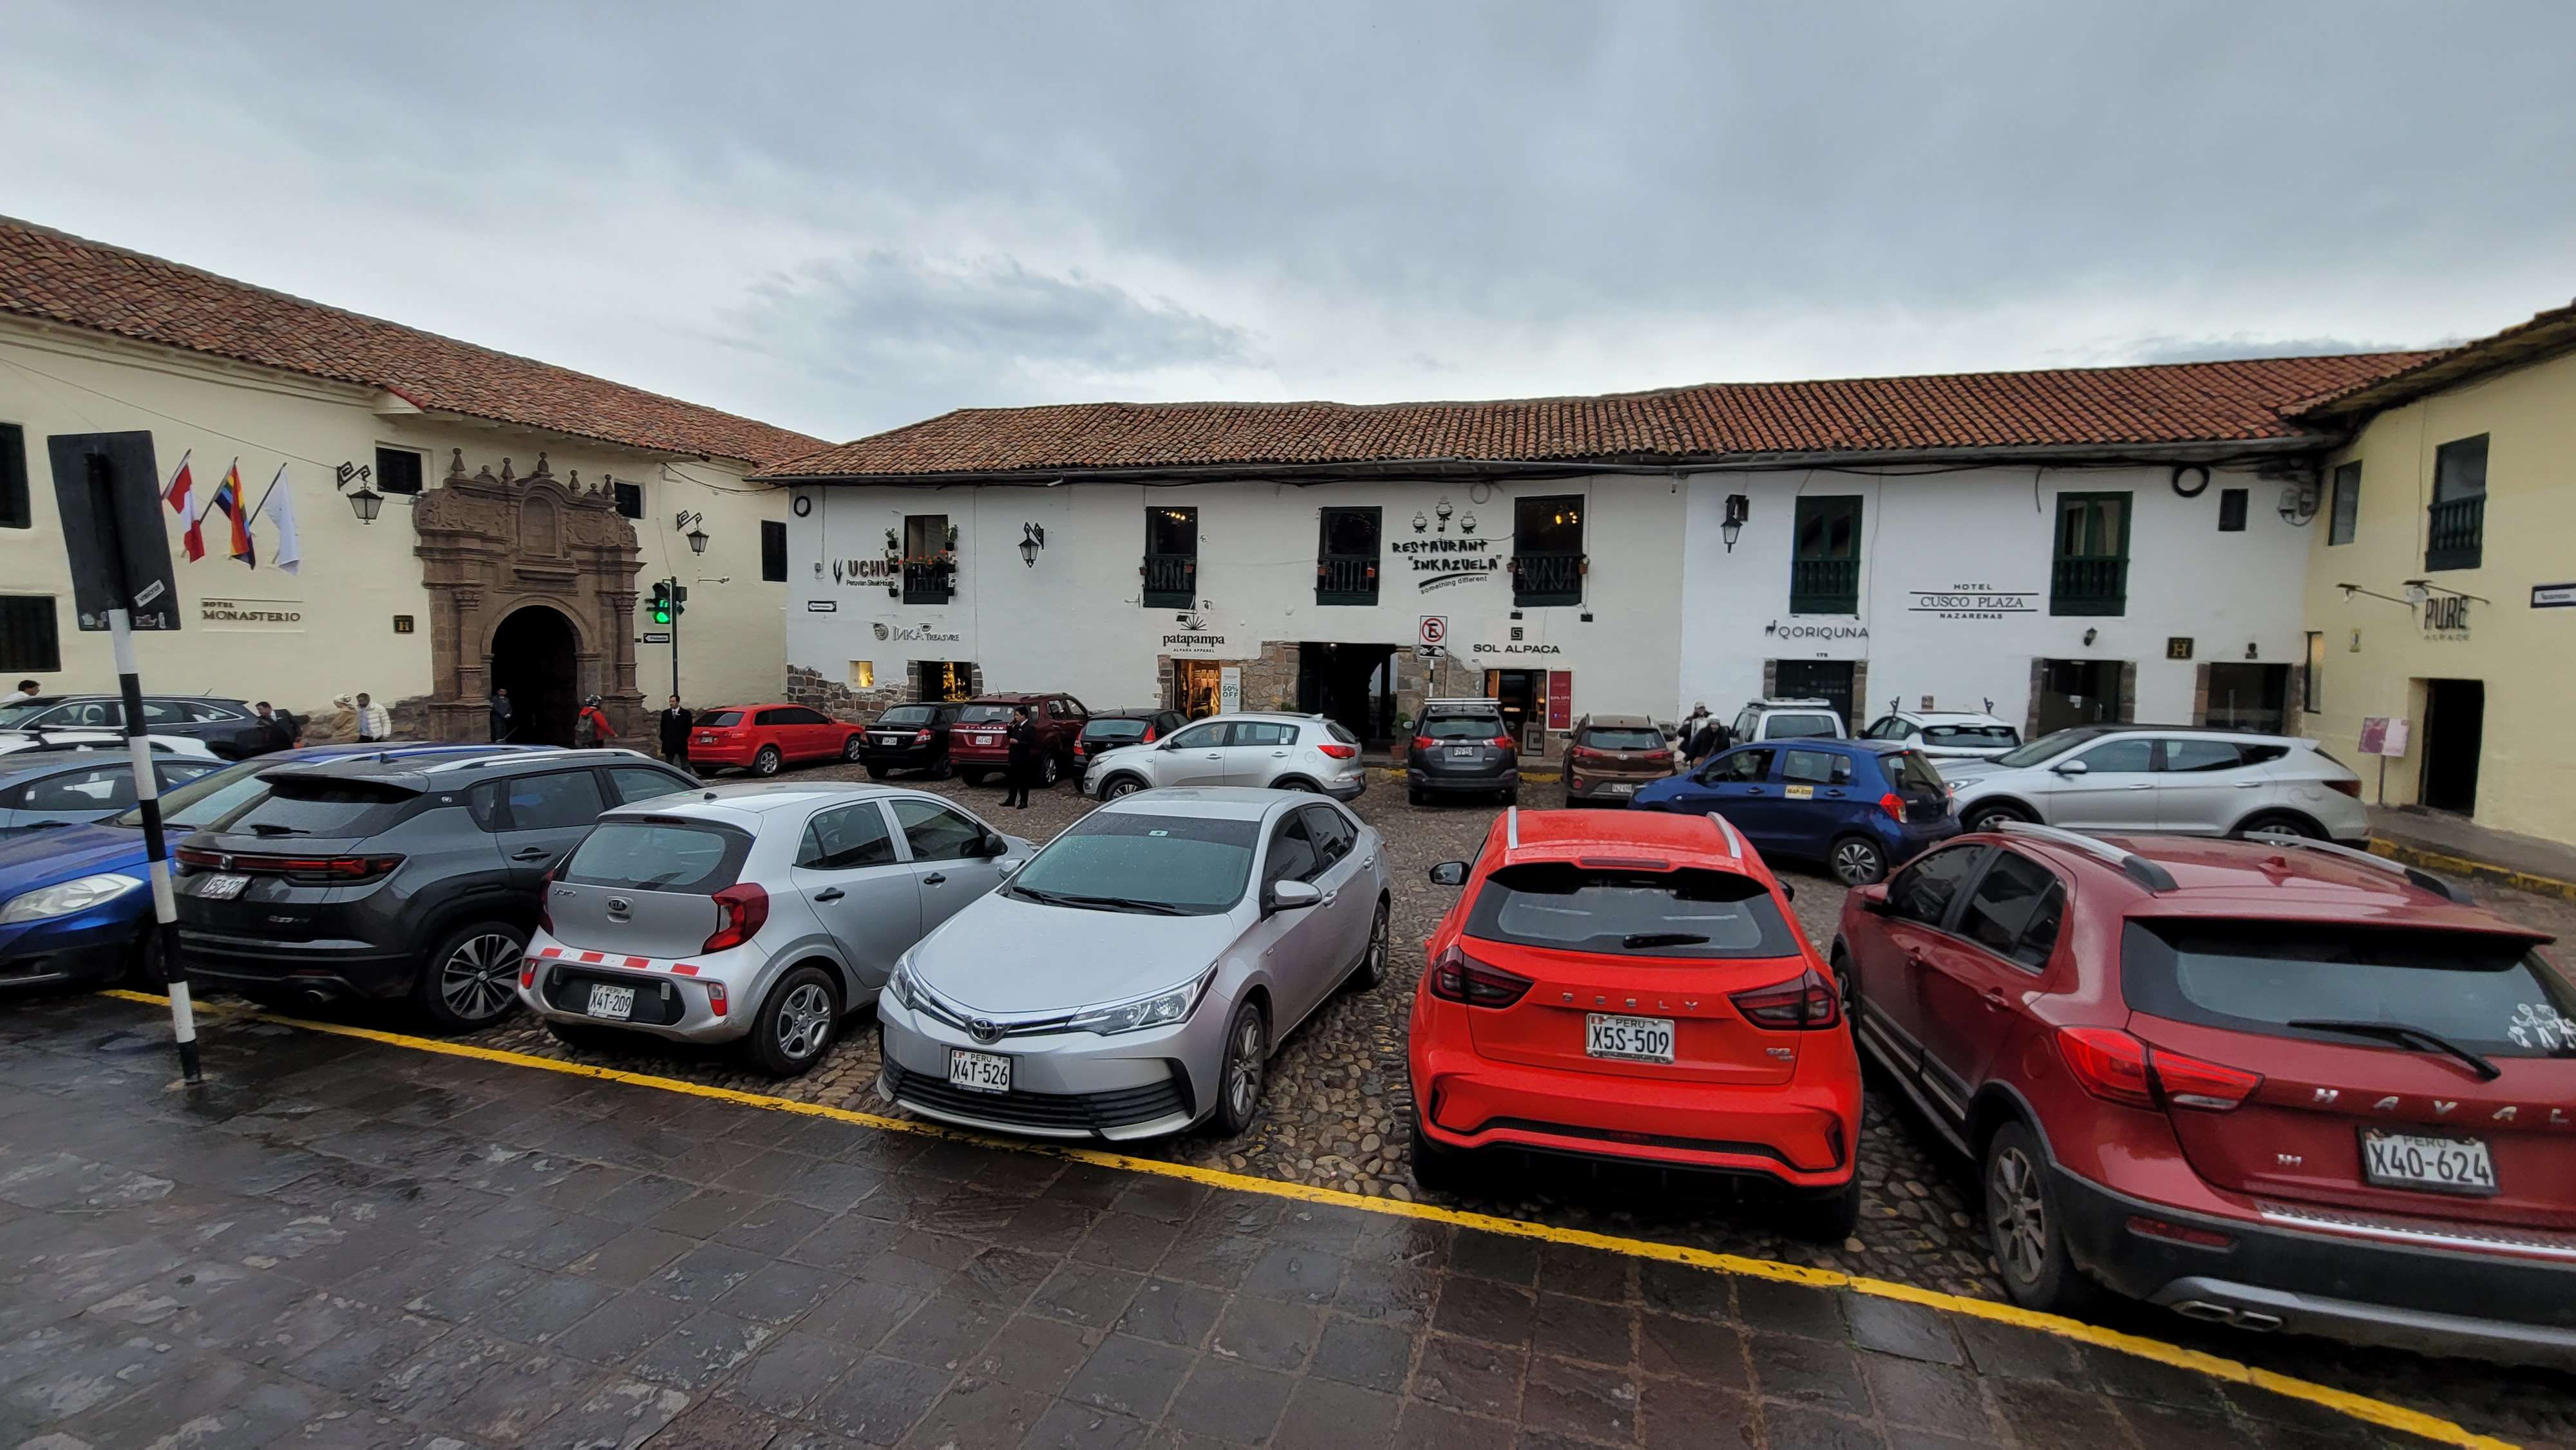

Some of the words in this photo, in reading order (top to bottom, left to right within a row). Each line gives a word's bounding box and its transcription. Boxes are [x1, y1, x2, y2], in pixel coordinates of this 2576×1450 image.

[1392, 540, 1488, 553] RESTAURANT
[848, 560, 891, 577] UCHU
[1408, 554, 1502, 572] "INKAZUELA"
[1421, 580, 1456, 594] something
[1458, 575, 1488, 584] different
[1920, 596, 1970, 607] CUSCO
[1978, 597, 2024, 608] PLAZA
[202, 610, 301, 621] MONASTERIO
[2424, 597, 2469, 629] PURE
[1778, 626, 1869, 640] QORIQUNA
[1163, 634, 1225, 647] patapampa
[1473, 644, 1501, 653] SOL
[1504, 645, 1560, 654] ALPACA
[2174, 643, 2186, 657] H
[610, 901, 623, 910] KIA
[590, 992, 631, 1013] X4T-209
[1616, 1019, 1645, 1028] PERU
[1593, 1026, 1669, 1054] X5S-509
[971, 1053, 992, 1062] PERU
[952, 1059, 1008, 1086] X4T-526
[2313, 1088, 2568, 1124] HAVAL
[2403, 1135, 2447, 1148] PERU
[2370, 1143, 2490, 1184] X40-624
